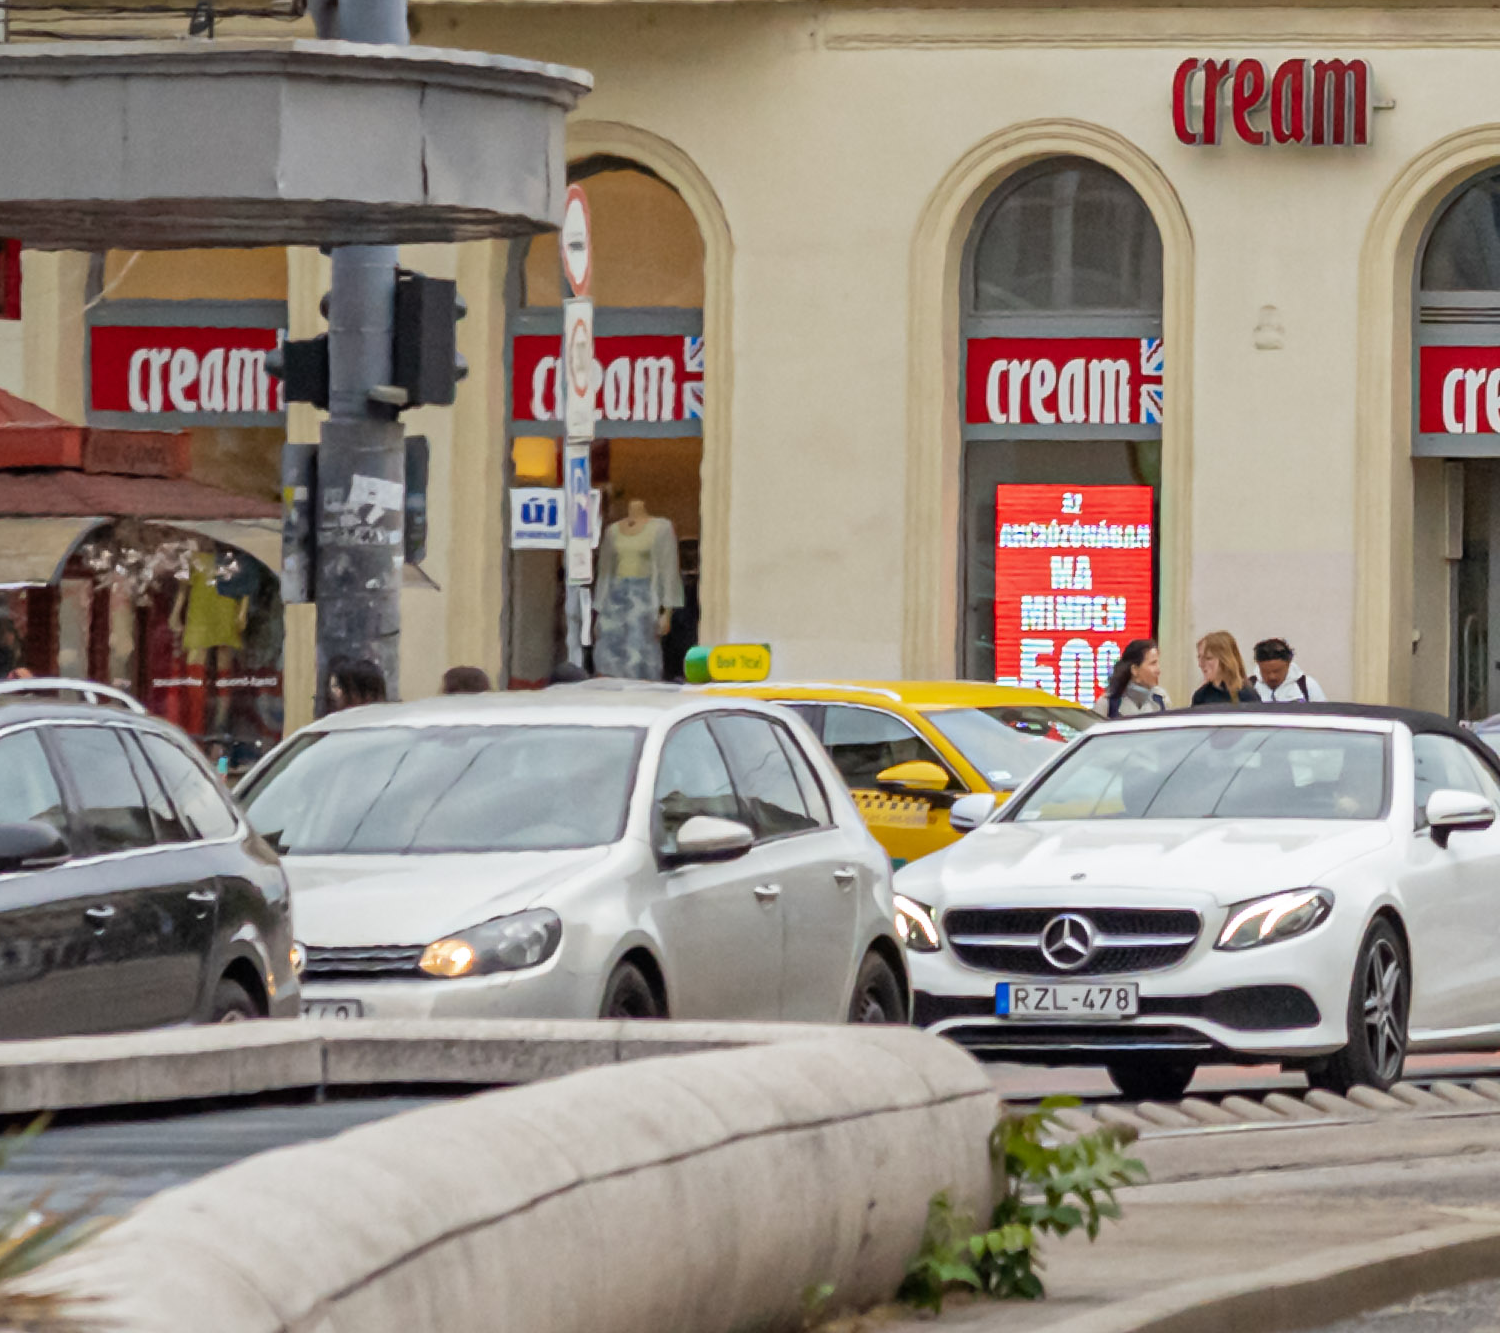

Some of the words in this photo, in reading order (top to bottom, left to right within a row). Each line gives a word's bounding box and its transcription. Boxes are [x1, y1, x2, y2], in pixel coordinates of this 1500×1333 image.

[1172, 58, 1373, 146] cream
[128, 347, 270, 413] cream
[987, 359, 1131, 424] cream
[1050, 555, 1093, 590] MA
[1020, 595, 1127, 631] MINDEN
[1014, 987, 1130, 1011] RZL-478
